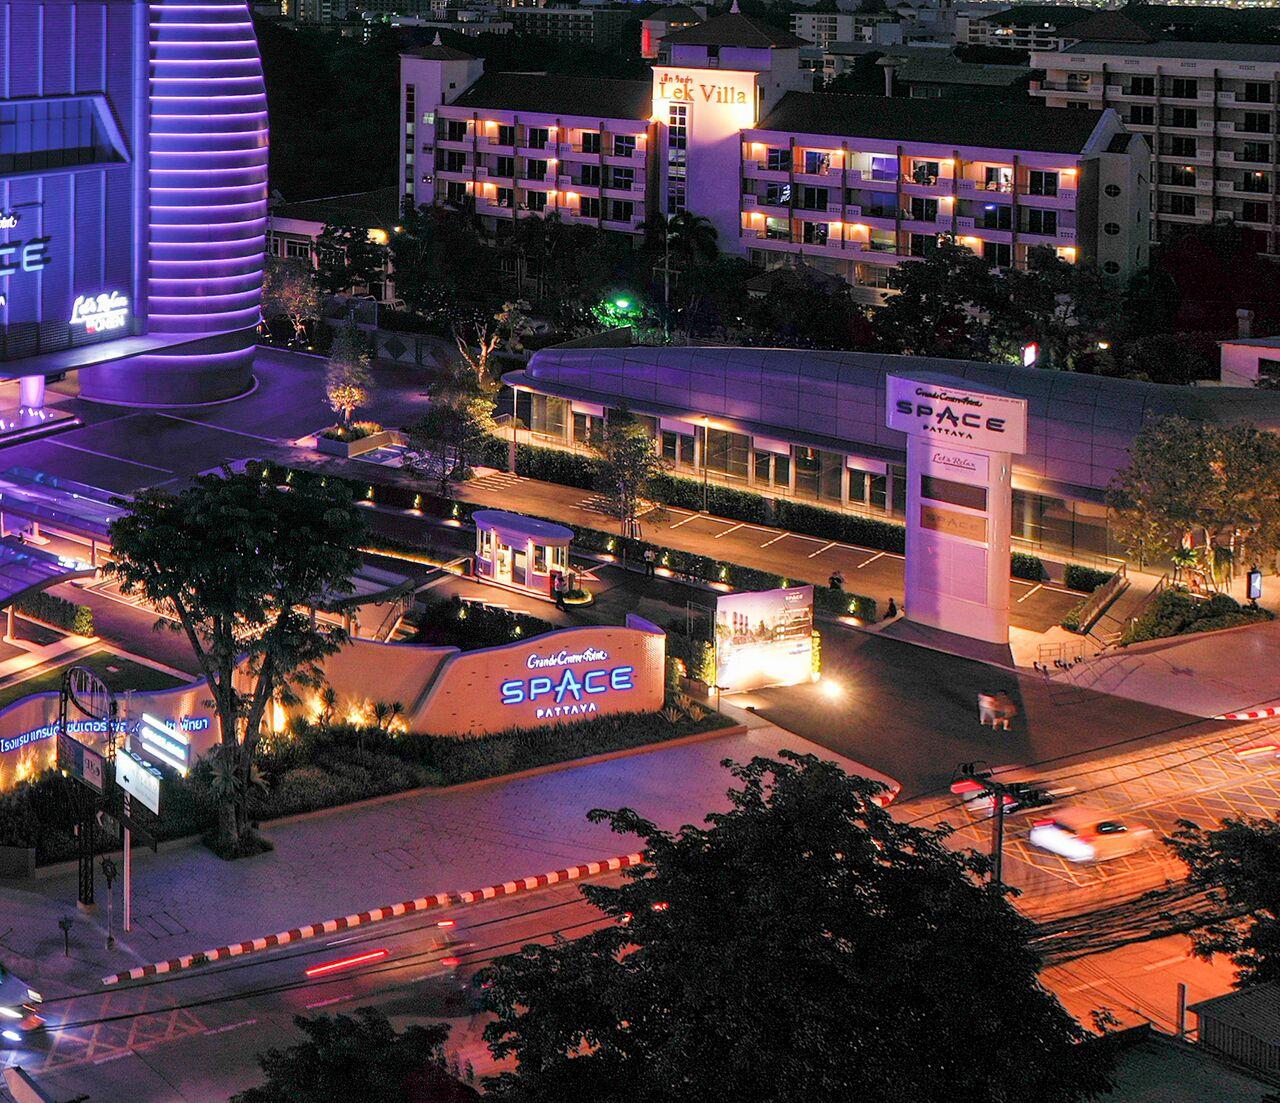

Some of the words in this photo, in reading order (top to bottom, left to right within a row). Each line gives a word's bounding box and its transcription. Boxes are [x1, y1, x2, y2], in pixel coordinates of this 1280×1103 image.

[659, 82, 694, 102] Lek
[699, 84, 747, 104] Villa
[896, 400, 1006, 433] SPACE
[923, 424, 973, 440] PATTAYA
[527, 653, 557, 669] Grande
[556, 650, 583, 665] Centre
[501, 667, 633, 704] SPACE
[536, 702, 596, 719] PATTAYA
[0, 734, 29, 753] โรงแรม
